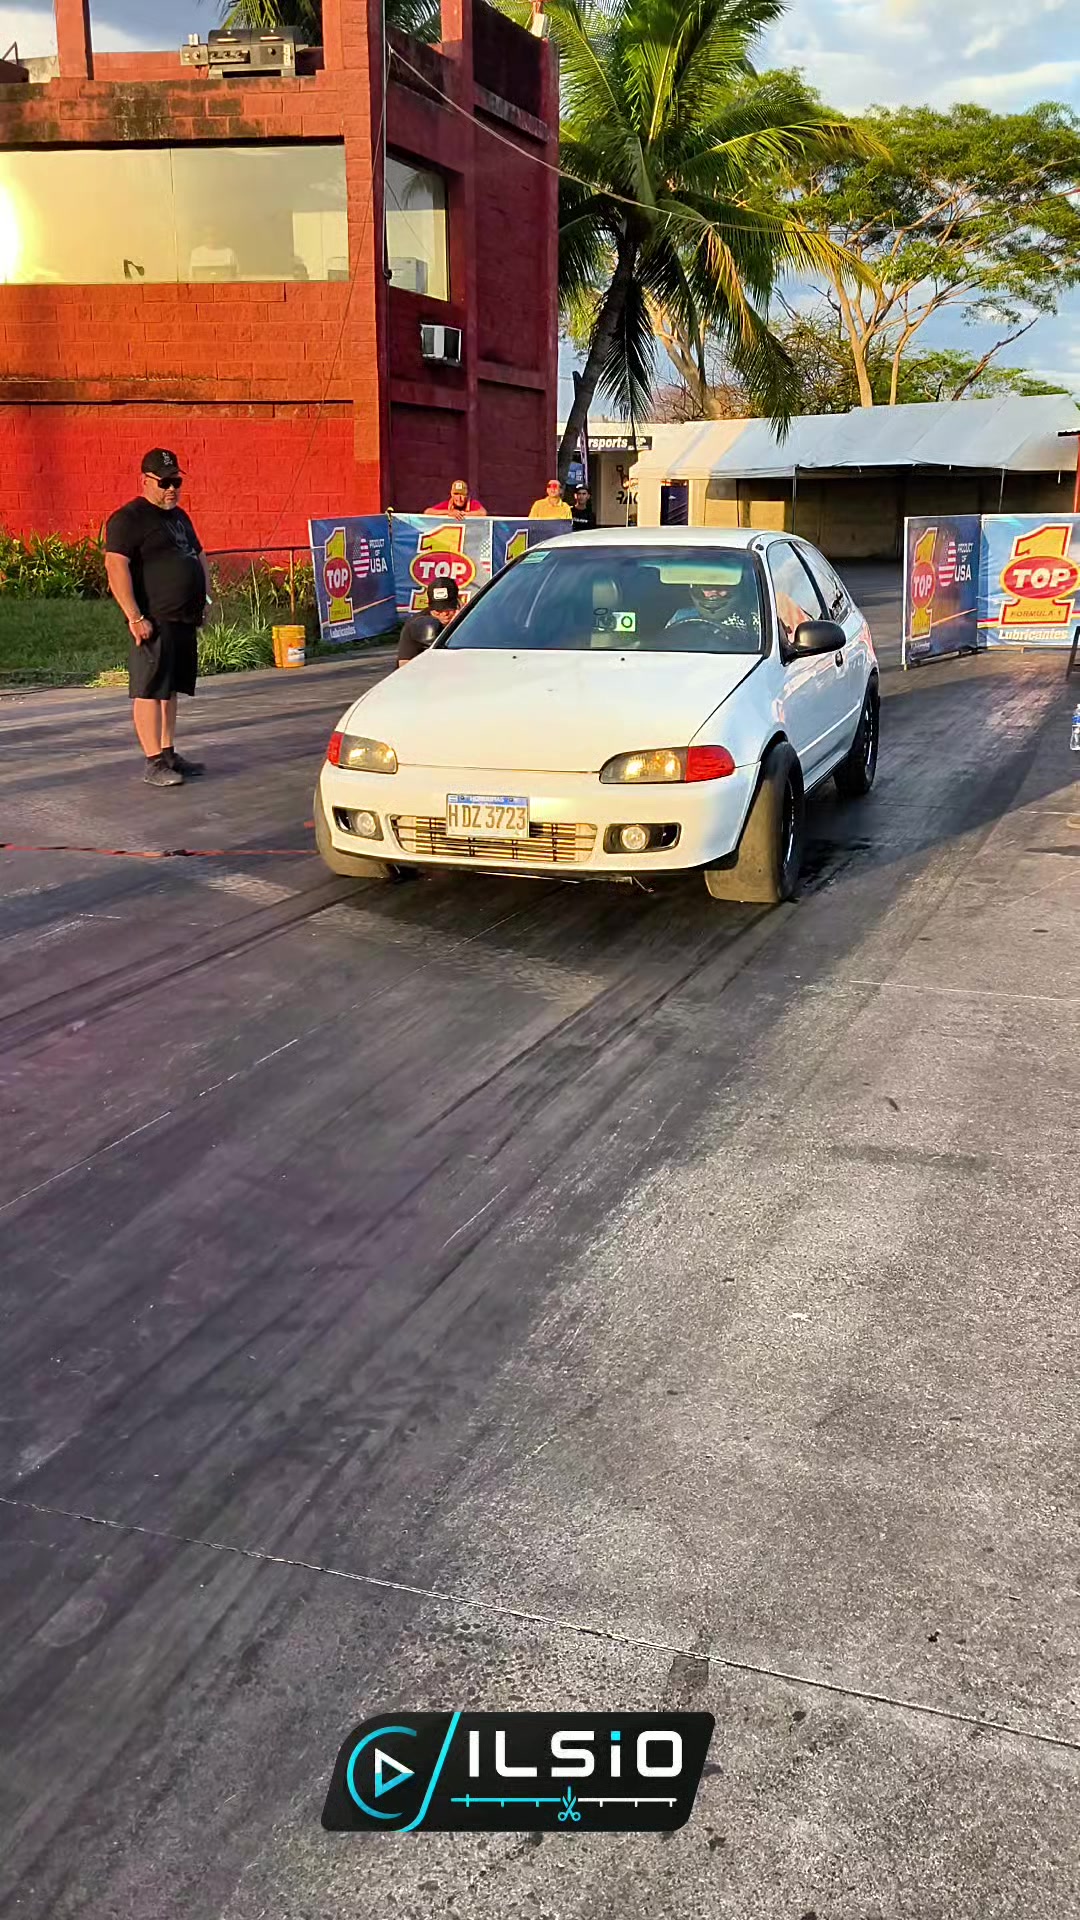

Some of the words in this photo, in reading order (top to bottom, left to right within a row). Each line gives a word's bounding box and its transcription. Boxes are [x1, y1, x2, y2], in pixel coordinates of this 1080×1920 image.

[370, 558, 388, 573] USA
[419, 561, 467, 580] TOP
[955, 565, 971, 581] USA
[326, 568, 349, 589] TOP
[913, 573, 933, 598] TOP
[1013, 567, 1071, 589] TOP
[1010, 610, 1054, 618] FORMULA
[998, 629, 1069, 641] Lubricantes
[485, 806, 526, 830] 3723
